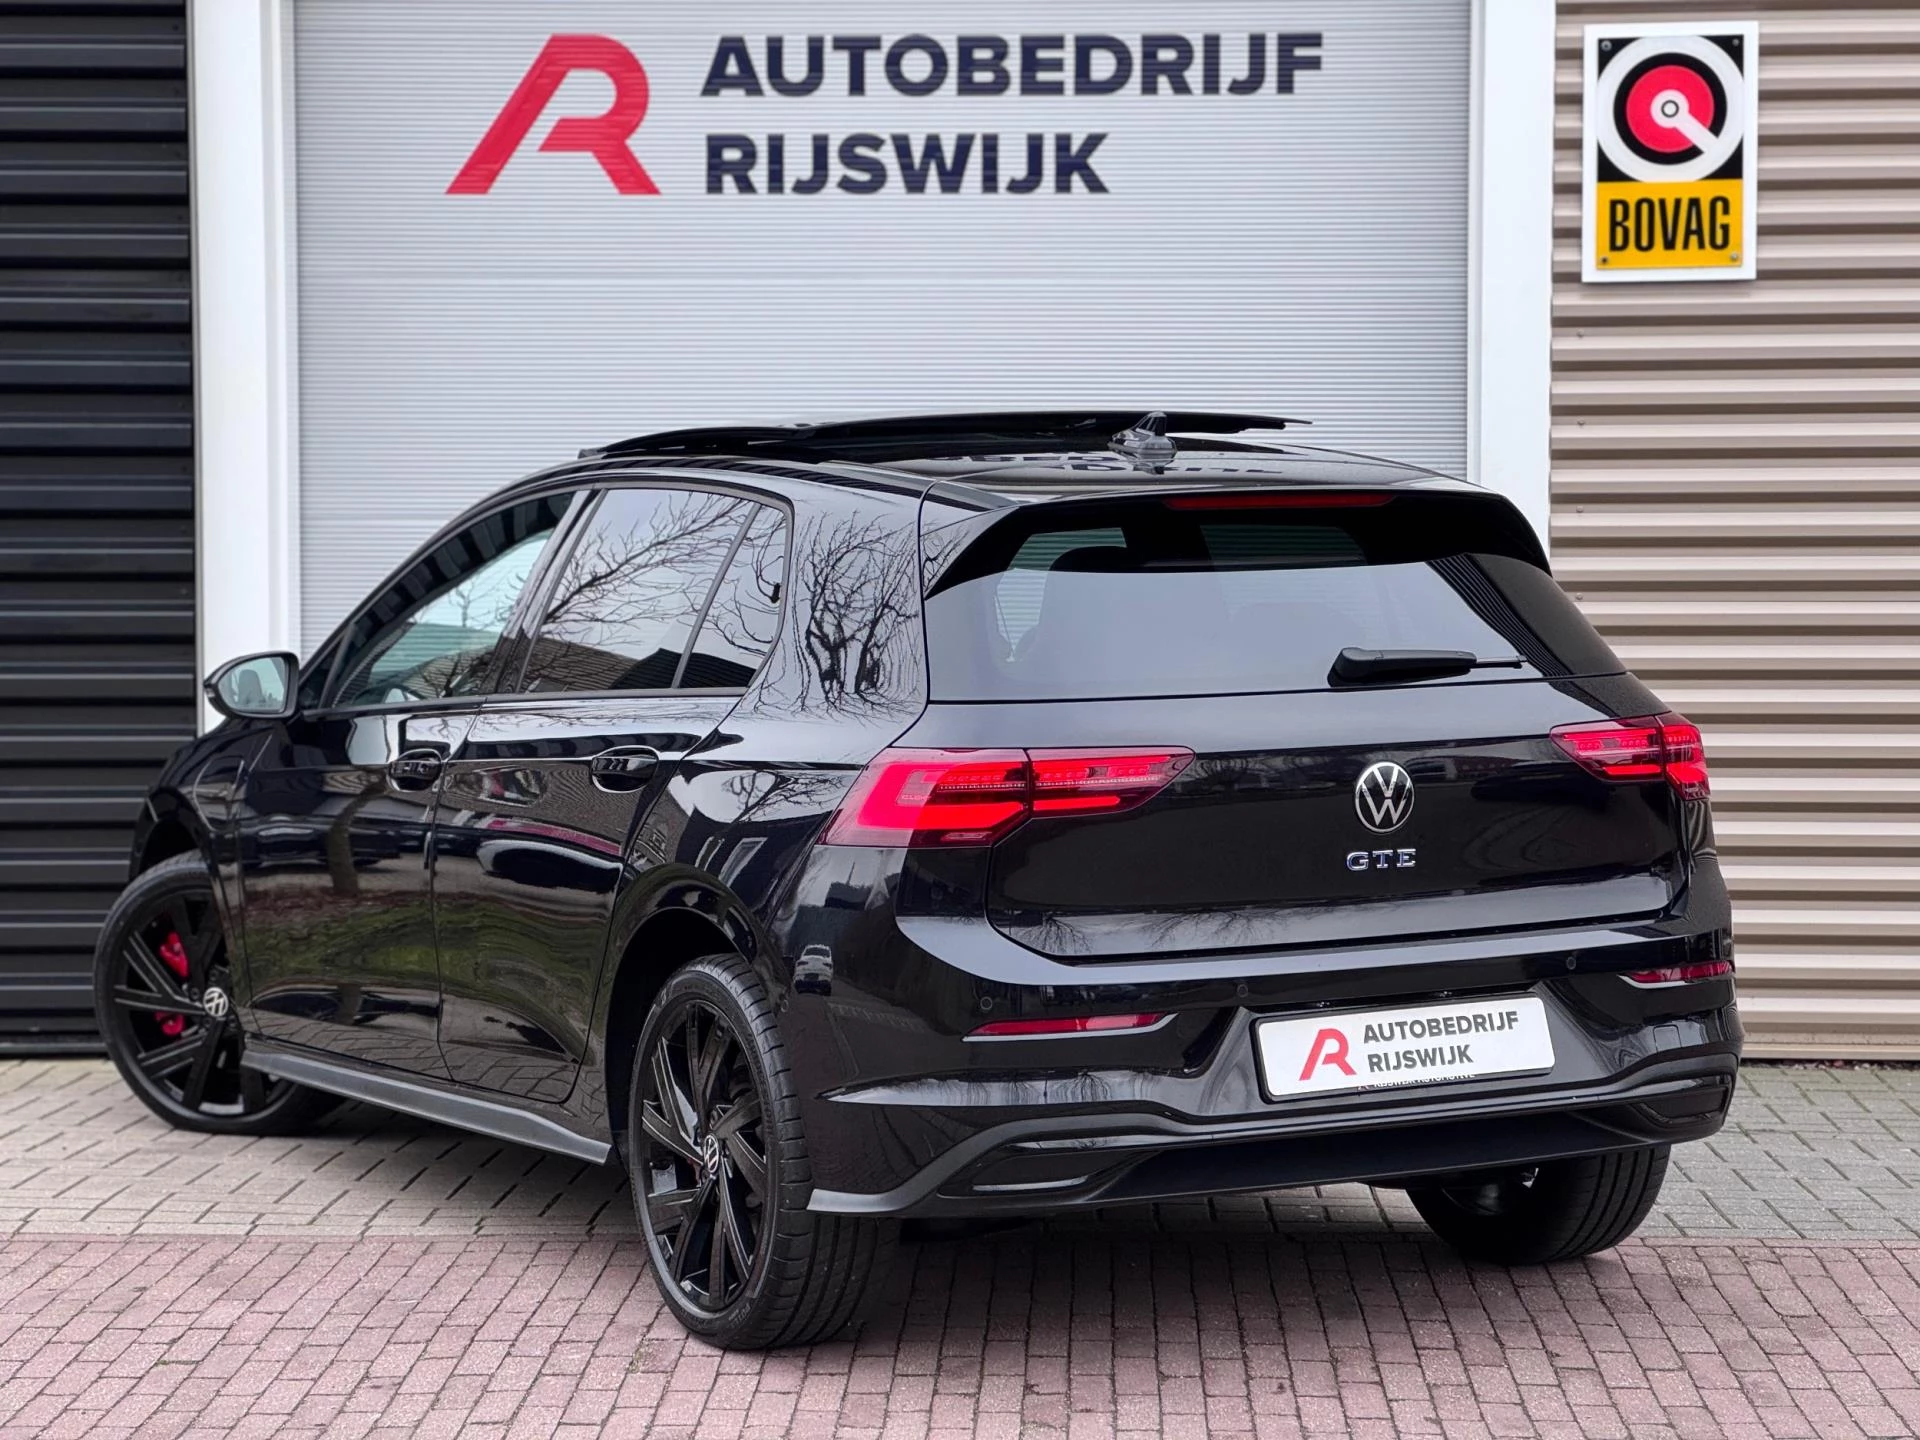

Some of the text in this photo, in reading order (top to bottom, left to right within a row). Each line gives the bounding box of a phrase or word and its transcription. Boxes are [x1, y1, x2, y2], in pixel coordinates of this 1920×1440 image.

[701, 32, 1323, 97] AUTOBEDRIJF
[706, 133, 1109, 195] RIJSWIJK
[1609, 196, 1730, 252] BOVAG
[1346, 848, 1416, 871] GTE
[1363, 1011, 1519, 1044] AUTOBEDRIJF
[1367, 1044, 1474, 1073] RIJSWIJK
